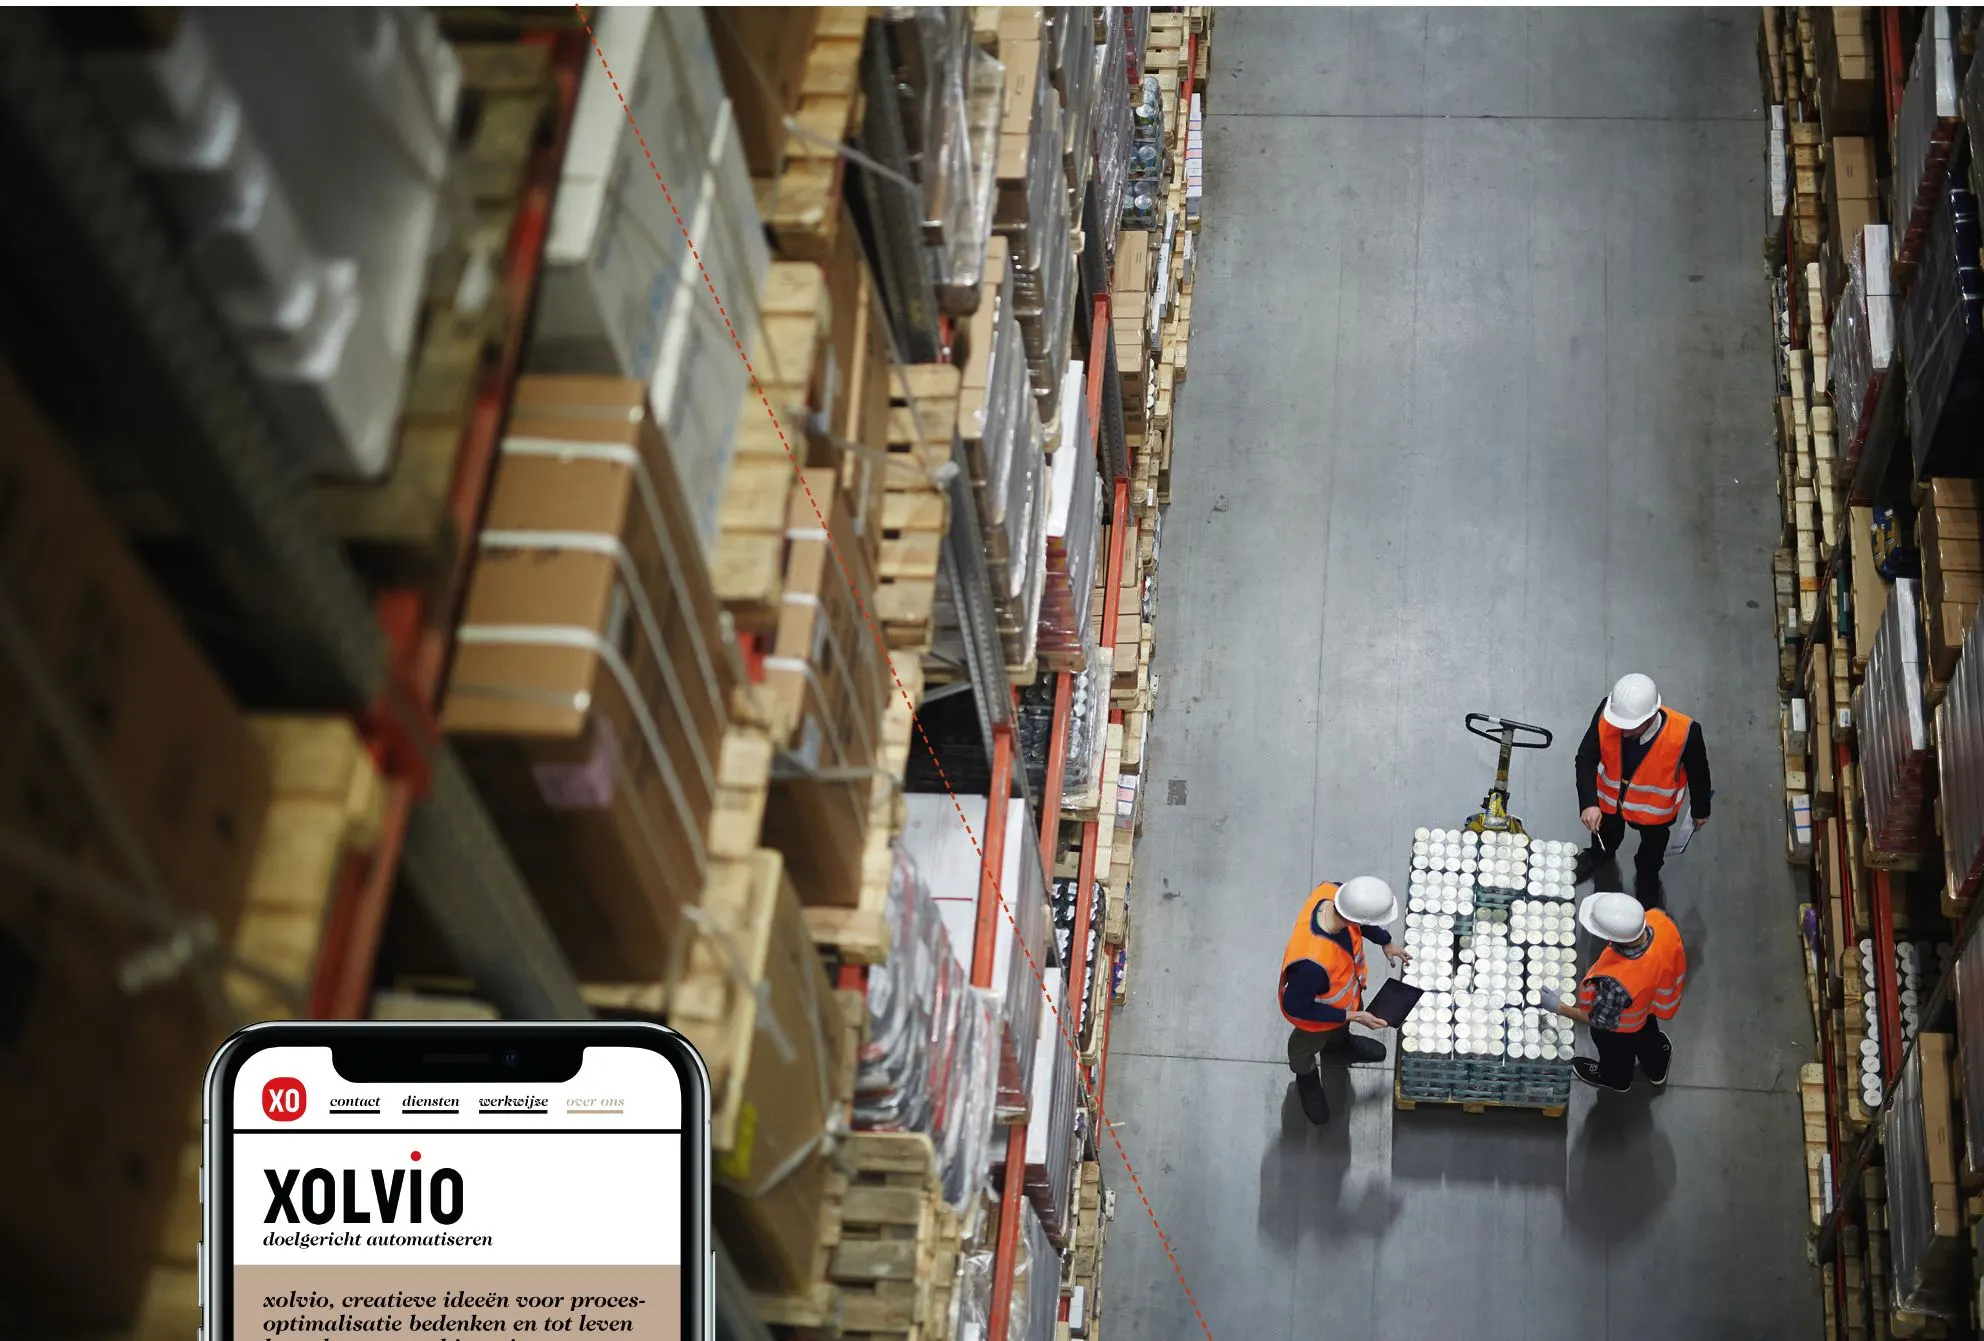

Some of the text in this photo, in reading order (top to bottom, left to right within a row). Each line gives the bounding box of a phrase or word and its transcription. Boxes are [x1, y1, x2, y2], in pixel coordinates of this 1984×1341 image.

[269, 1088, 299, 1113] XO
[330, 1096, 381, 1107] contact
[402, 1095, 460, 1107] diensten
[479, 1095, 549, 1110] werkwijze
[566, 1097, 625, 1107] over ons
[263, 1232, 493, 1250] doelgericht automatiseren
[263, 1290, 646, 1312] xolvio, creatieve ideeën voor proces-
[263, 1313, 634, 1334] optimalisatie bedenken en tot leven
